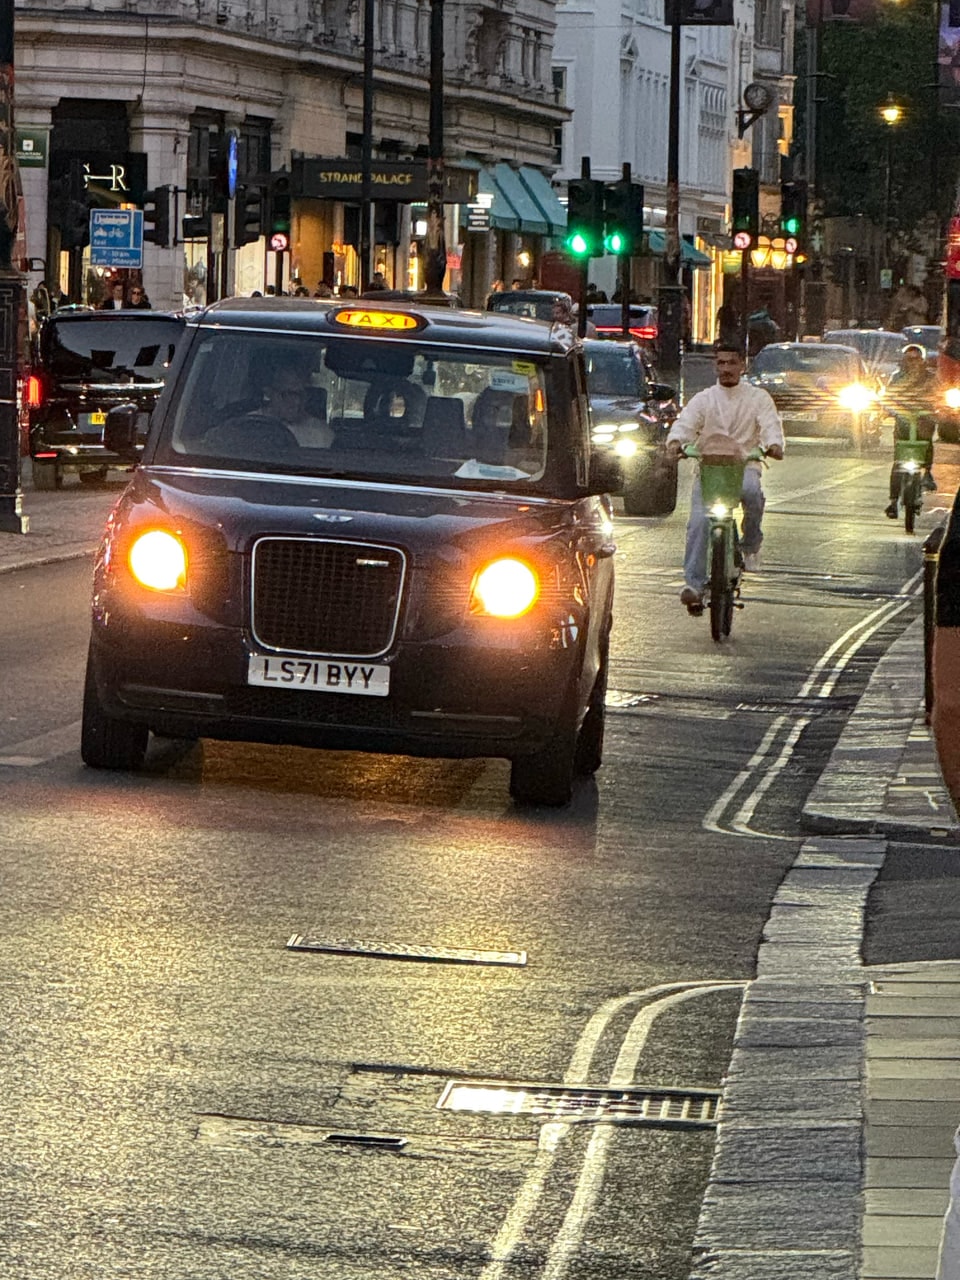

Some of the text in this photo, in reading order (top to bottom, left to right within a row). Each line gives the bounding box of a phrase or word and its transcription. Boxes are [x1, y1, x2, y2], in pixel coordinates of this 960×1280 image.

[344, 313, 409, 327] TAXI
[263, 659, 375, 689] LS71 BYY
